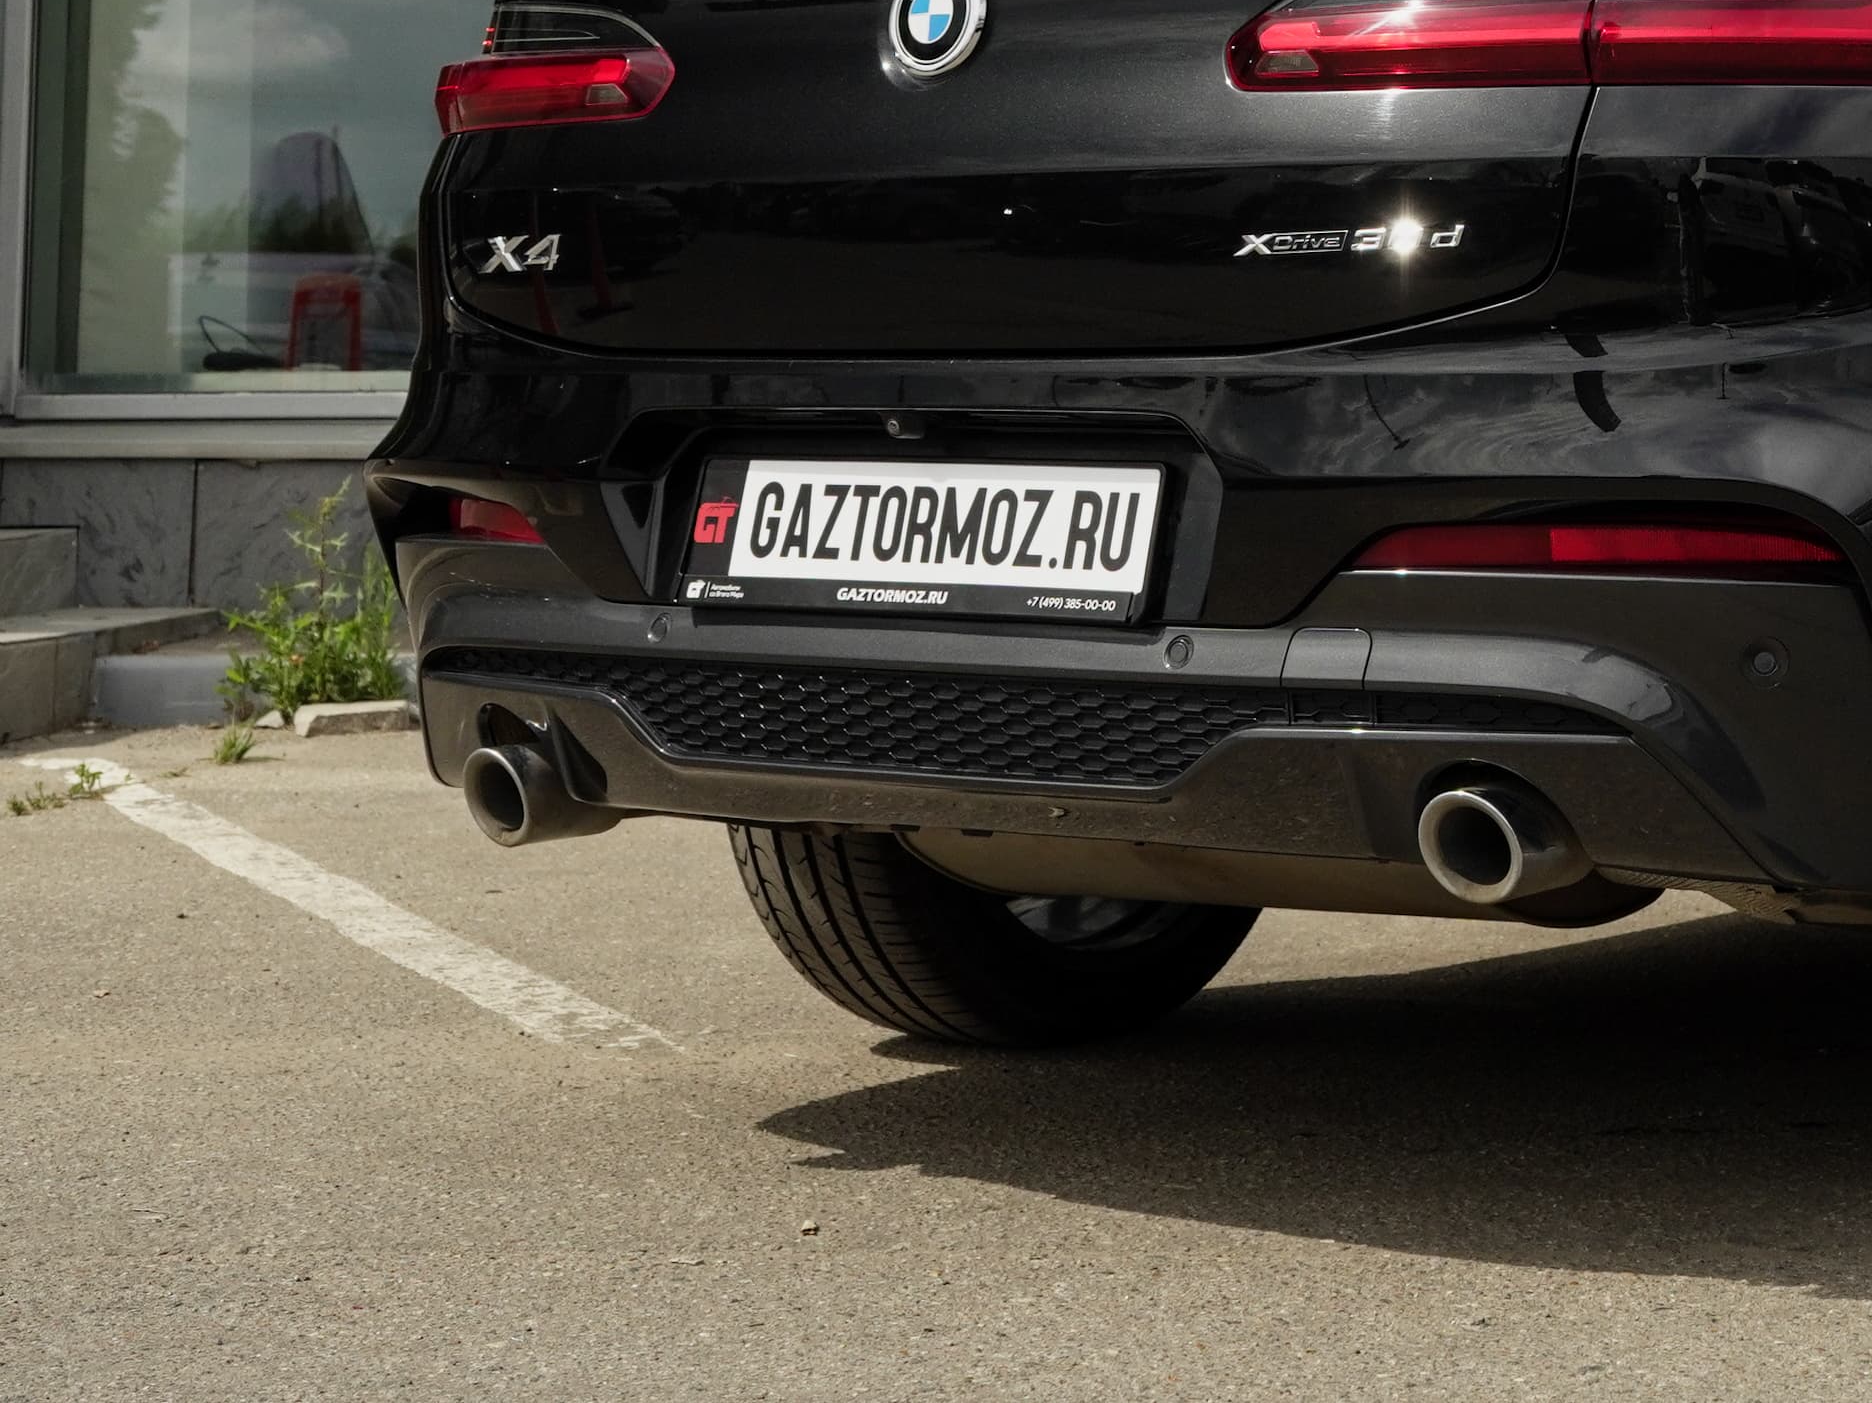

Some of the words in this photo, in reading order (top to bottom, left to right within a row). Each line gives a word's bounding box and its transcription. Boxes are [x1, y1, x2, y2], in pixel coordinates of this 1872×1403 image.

[478, 234, 561, 273] X4
[750, 481, 1140, 572] GAZTORMOZ.RU
[836, 587, 948, 604] GAZTORMOZ.RU
[1063, 598, 1116, 611] 385-00-00
